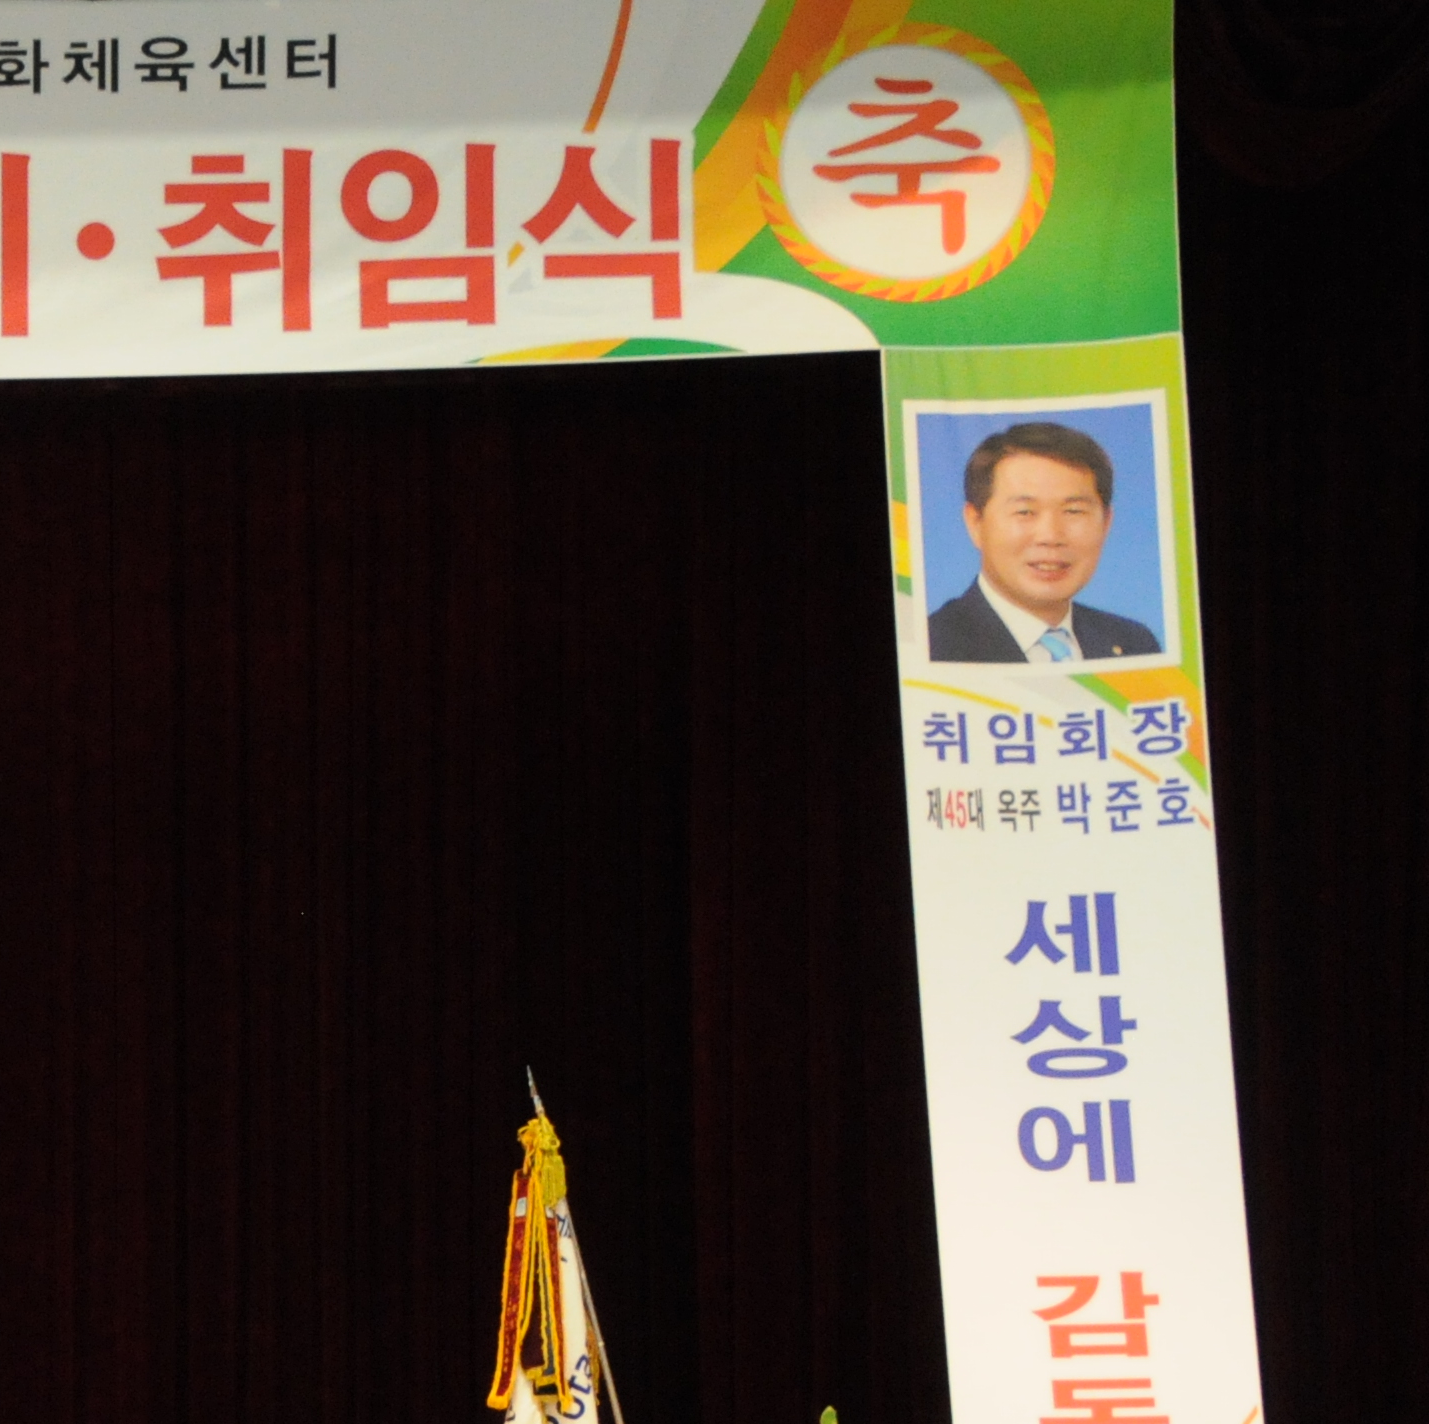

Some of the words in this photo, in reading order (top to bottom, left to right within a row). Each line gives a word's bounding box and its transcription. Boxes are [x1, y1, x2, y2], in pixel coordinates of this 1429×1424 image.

[811, 76, 1002, 256] 축
[926, 787, 985, 832] 제45대
[997, 789, 1041, 832] 옥주
[1056, 777, 1195, 835] 박준호
[1003, 891, 1139, 1185] 세상에
